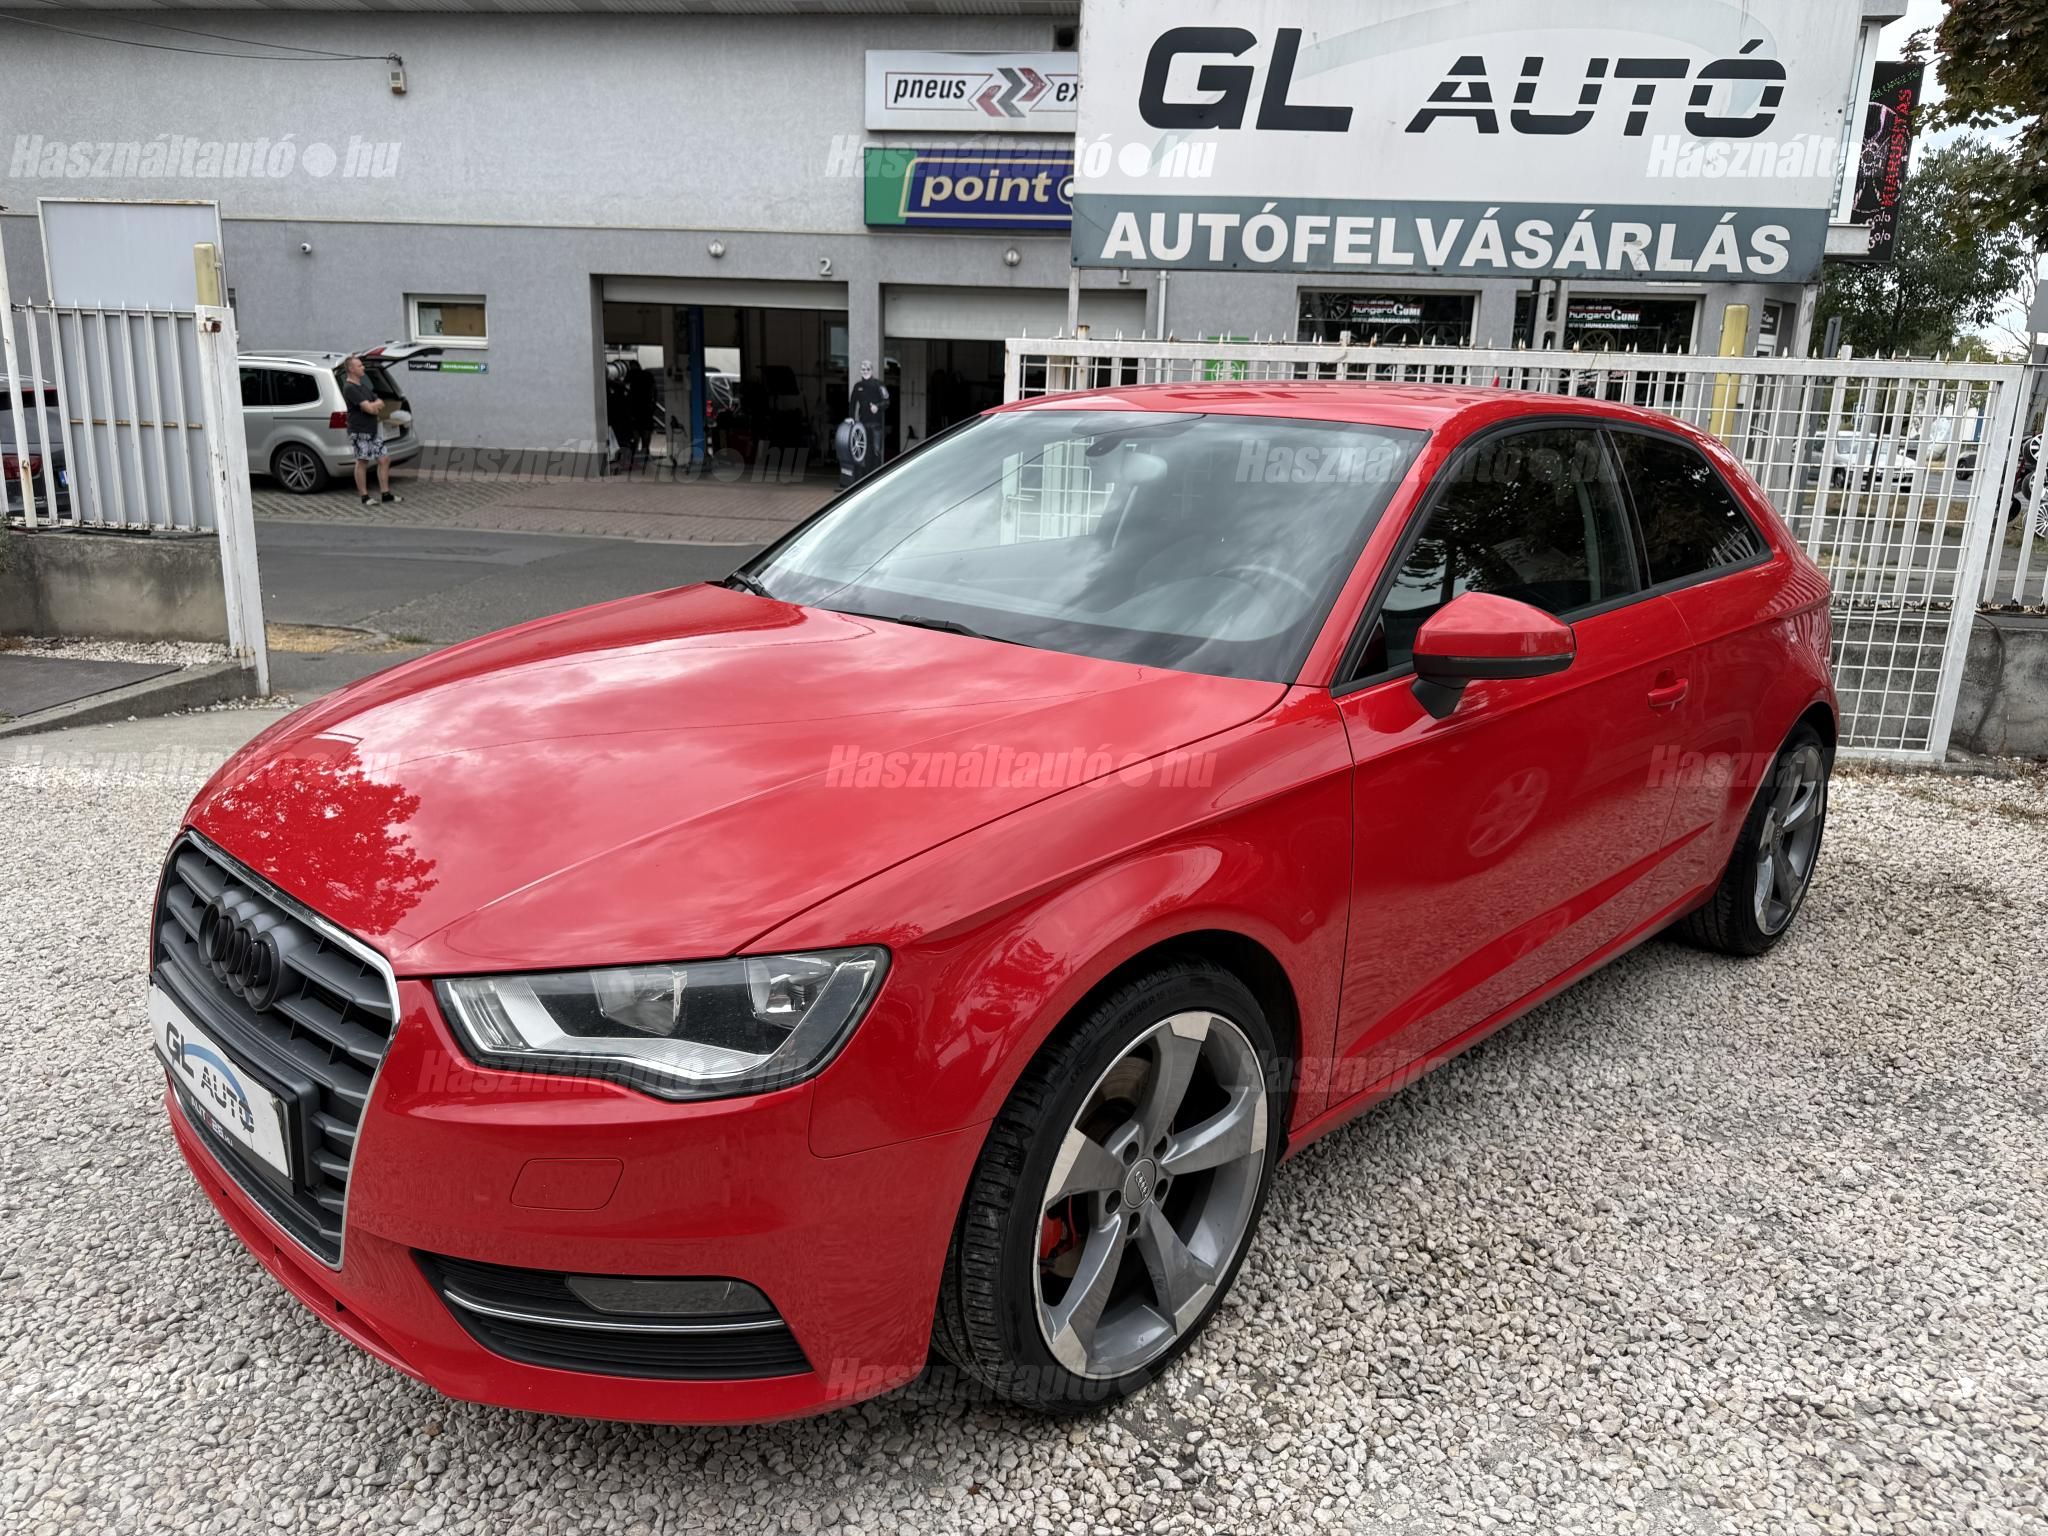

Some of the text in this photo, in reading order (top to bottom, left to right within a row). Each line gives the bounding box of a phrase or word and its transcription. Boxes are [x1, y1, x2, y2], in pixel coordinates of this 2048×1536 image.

[893, 78, 967, 104] pneus
[1138, 26, 1787, 138] GL AUTÓ
[920, 169, 1052, 208] point
[1100, 201, 1791, 276] AUTÓFELVÁSÁRLÁS
[819, 257, 833, 277] 2
[165, 1021, 195, 1079] GL
